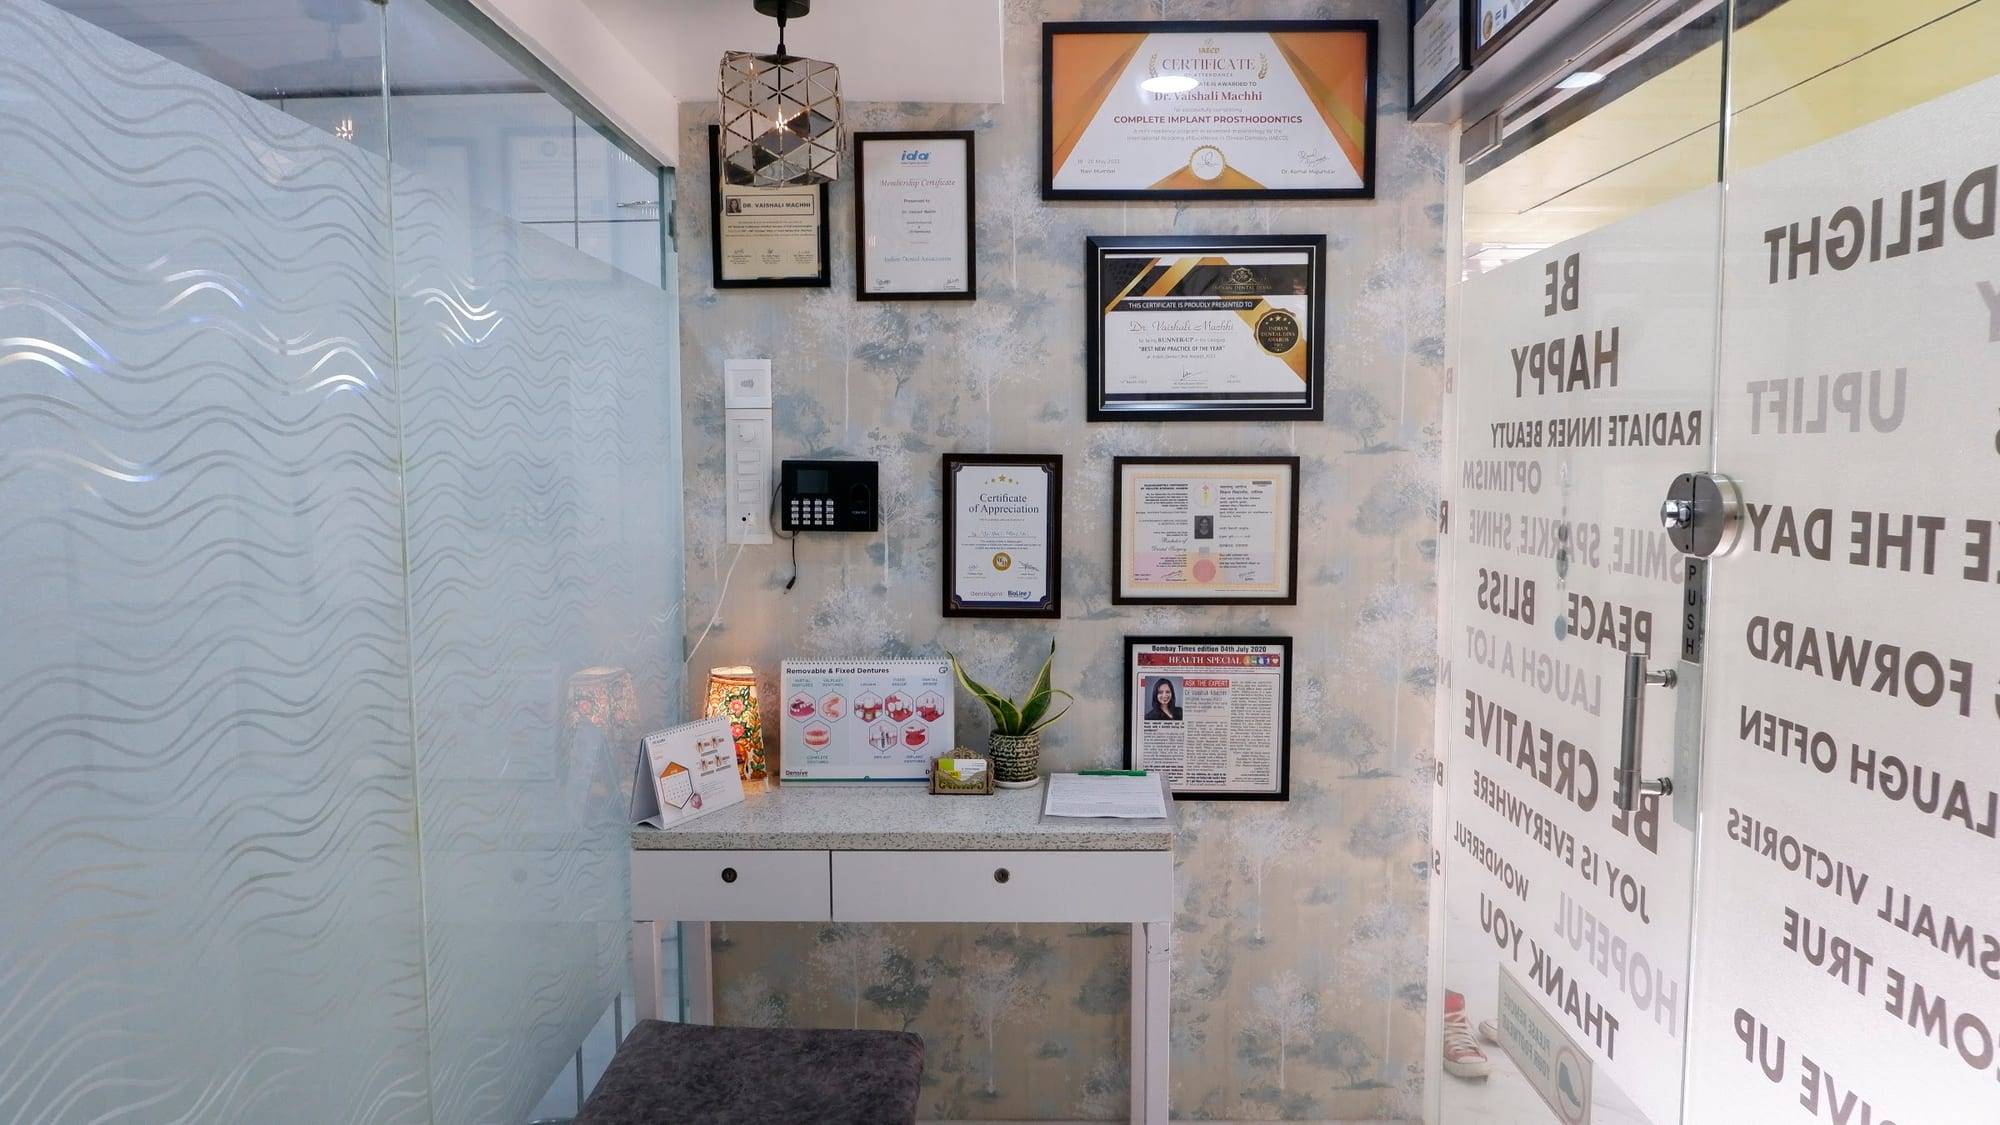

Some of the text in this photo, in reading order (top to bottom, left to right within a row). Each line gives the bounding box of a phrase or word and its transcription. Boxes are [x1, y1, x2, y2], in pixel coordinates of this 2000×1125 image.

[1161, 58, 1255, 71] CERTIFICATE
[1155, 91, 1262, 101] Dr. Vaishali Machhi
[1113, 115, 1303, 124] COMPLETE IMPLANT PROSTHODONTICS
[881, 178, 956, 188] Membership Certificate
[979, 493, 1028, 503] Certificate
[968, 503, 1039, 515] of Appreciation
[1686, 565, 1697, 655] PUSH
[1151, 645, 1177, 653] Bombay
[1168, 656, 1240, 664] HEALTH SPECIAL
